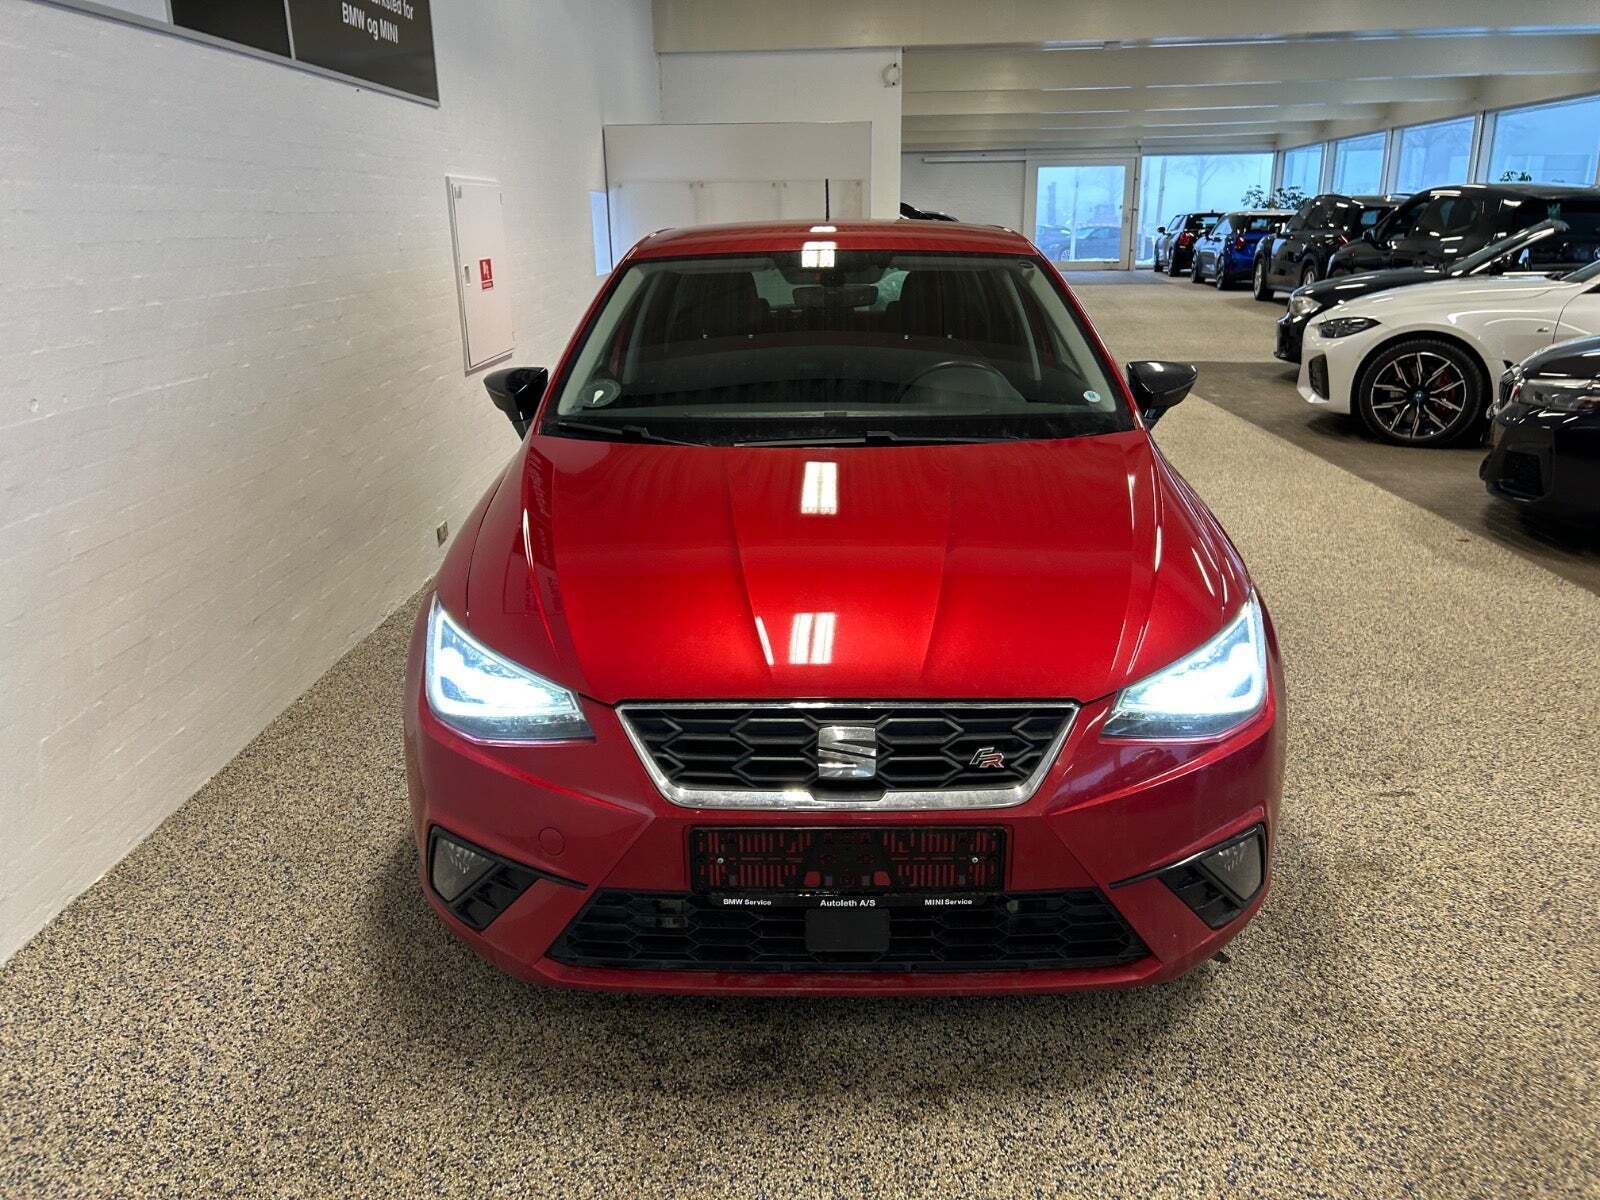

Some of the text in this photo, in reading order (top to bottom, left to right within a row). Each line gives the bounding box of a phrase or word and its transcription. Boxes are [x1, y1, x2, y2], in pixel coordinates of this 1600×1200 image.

[403, 0, 414, 20] for
[342, 1, 399, 44] BMW og MINI
[744, 898, 772, 906] Service
[820, 899, 876, 907] Autoleth A/S
[924, 898, 944, 906] MINI
